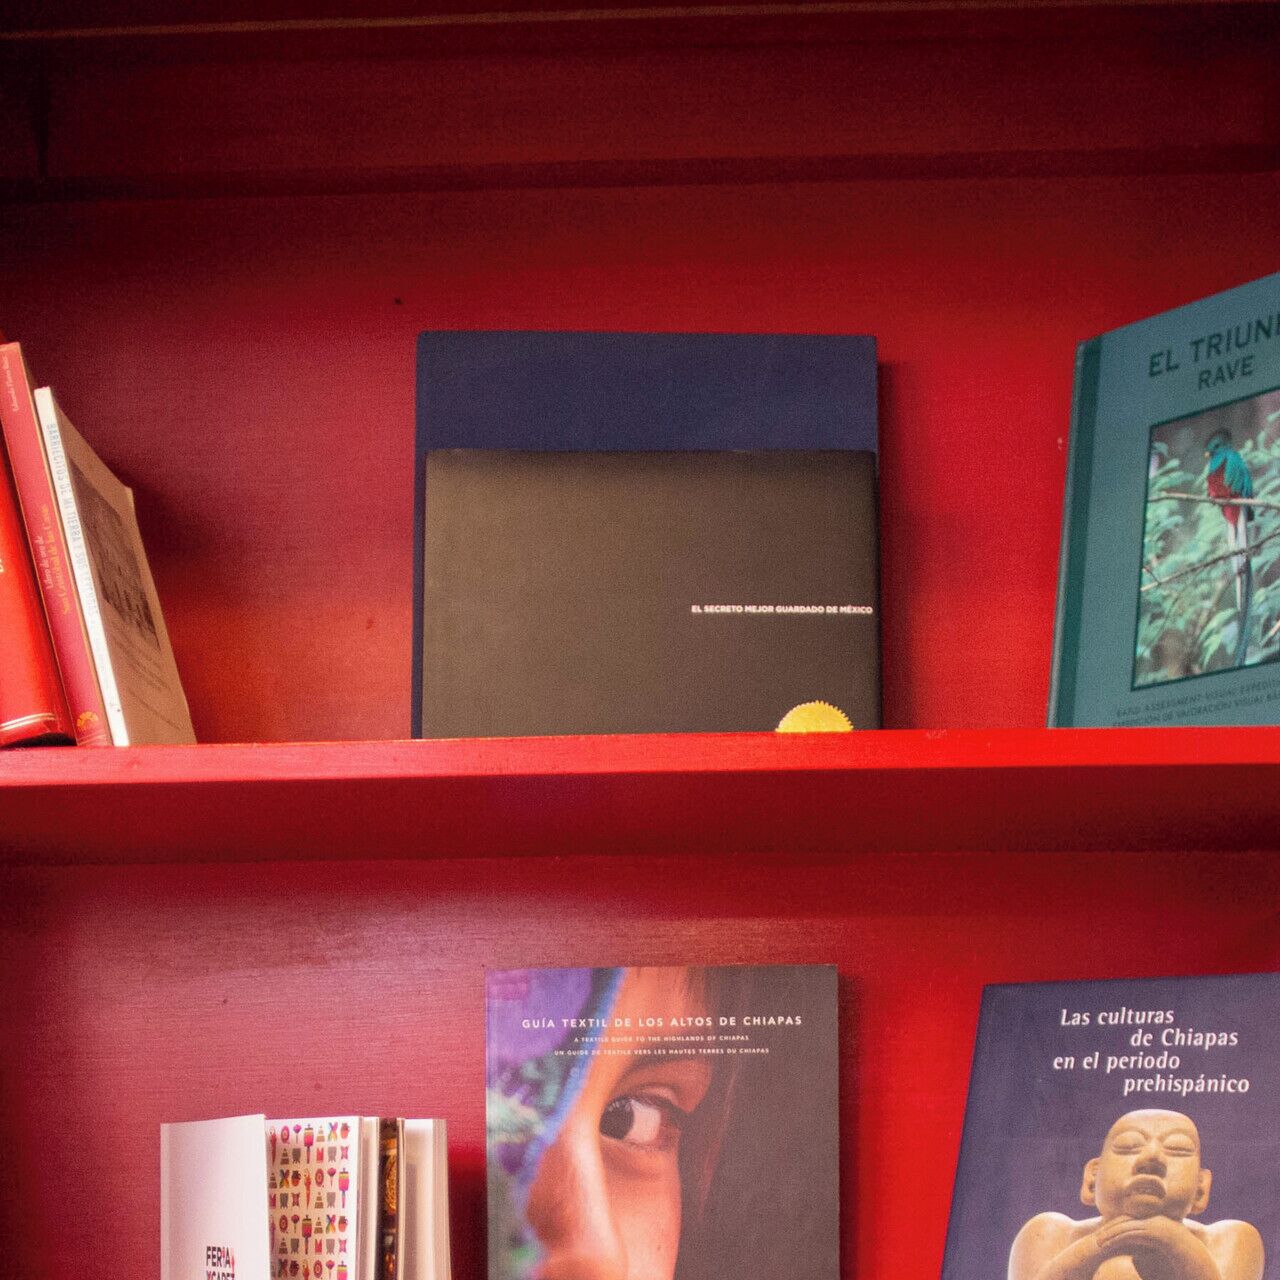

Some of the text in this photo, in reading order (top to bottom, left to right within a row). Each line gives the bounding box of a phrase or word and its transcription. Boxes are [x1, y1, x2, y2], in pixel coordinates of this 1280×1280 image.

[1148, 350, 1180, 378] EL
[1198, 354, 1256, 391] RAVE
[691, 604, 873, 615] EL SECRETO MEJOR GUARDADO DE MÉXICO
[521, 1015, 803, 1029] GUÍA TEXTIL DE LOS ALTOS DE CHIAPAS
[1061, 1006, 1174, 1026] Las culturas
[1130, 1027, 1239, 1051] de Chiapas
[1053, 1051, 1181, 1074] en el periodo
[1123, 1074, 1250, 1097] prehispánico
[206, 1245, 231, 1269] FERIA
